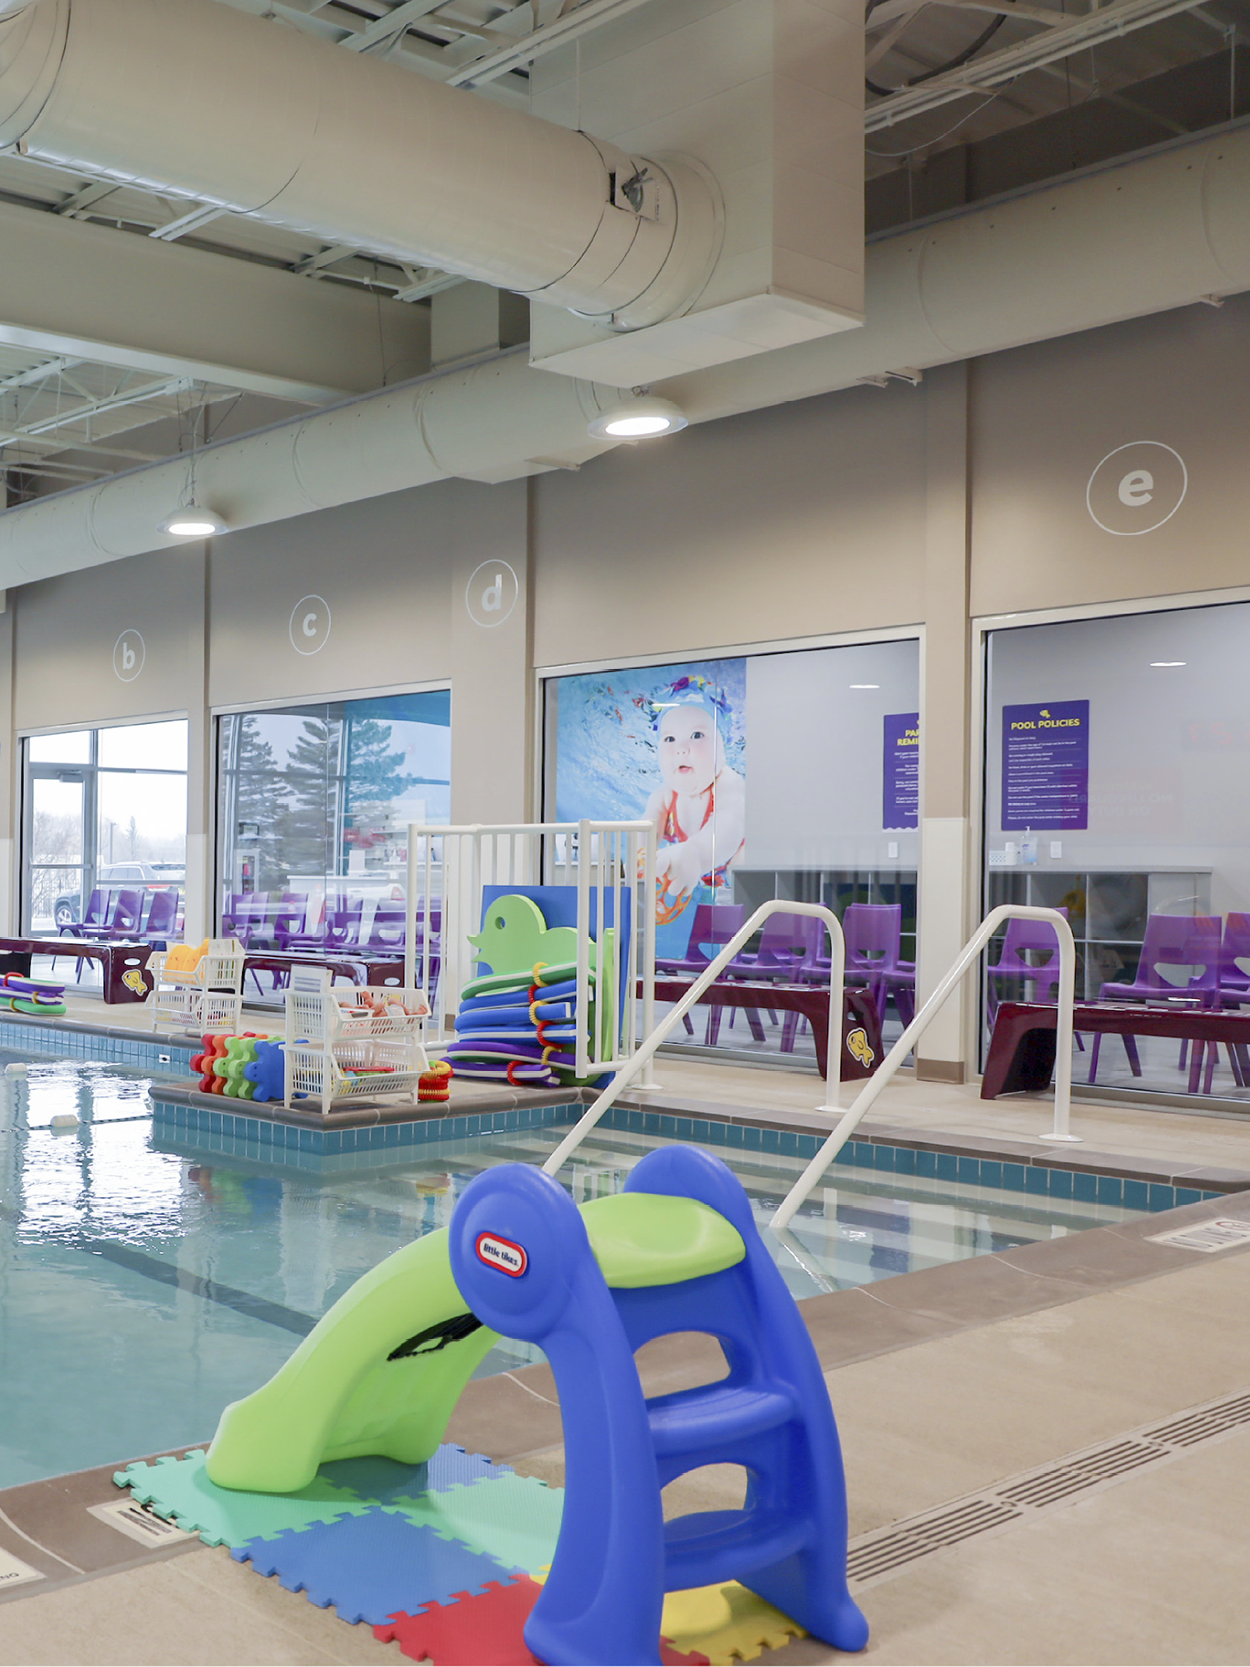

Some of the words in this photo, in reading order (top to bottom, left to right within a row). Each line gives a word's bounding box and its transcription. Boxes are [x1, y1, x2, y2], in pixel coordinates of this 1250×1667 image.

[1118, 469, 1154, 507] e
[481, 573, 503, 613] d
[302, 612, 318, 637] c
[122, 641, 136, 670] b
[1010, 721, 1037, 730] POOL
[1038, 718, 1081, 728] POLICIES
[483, 1243, 500, 1258] little
